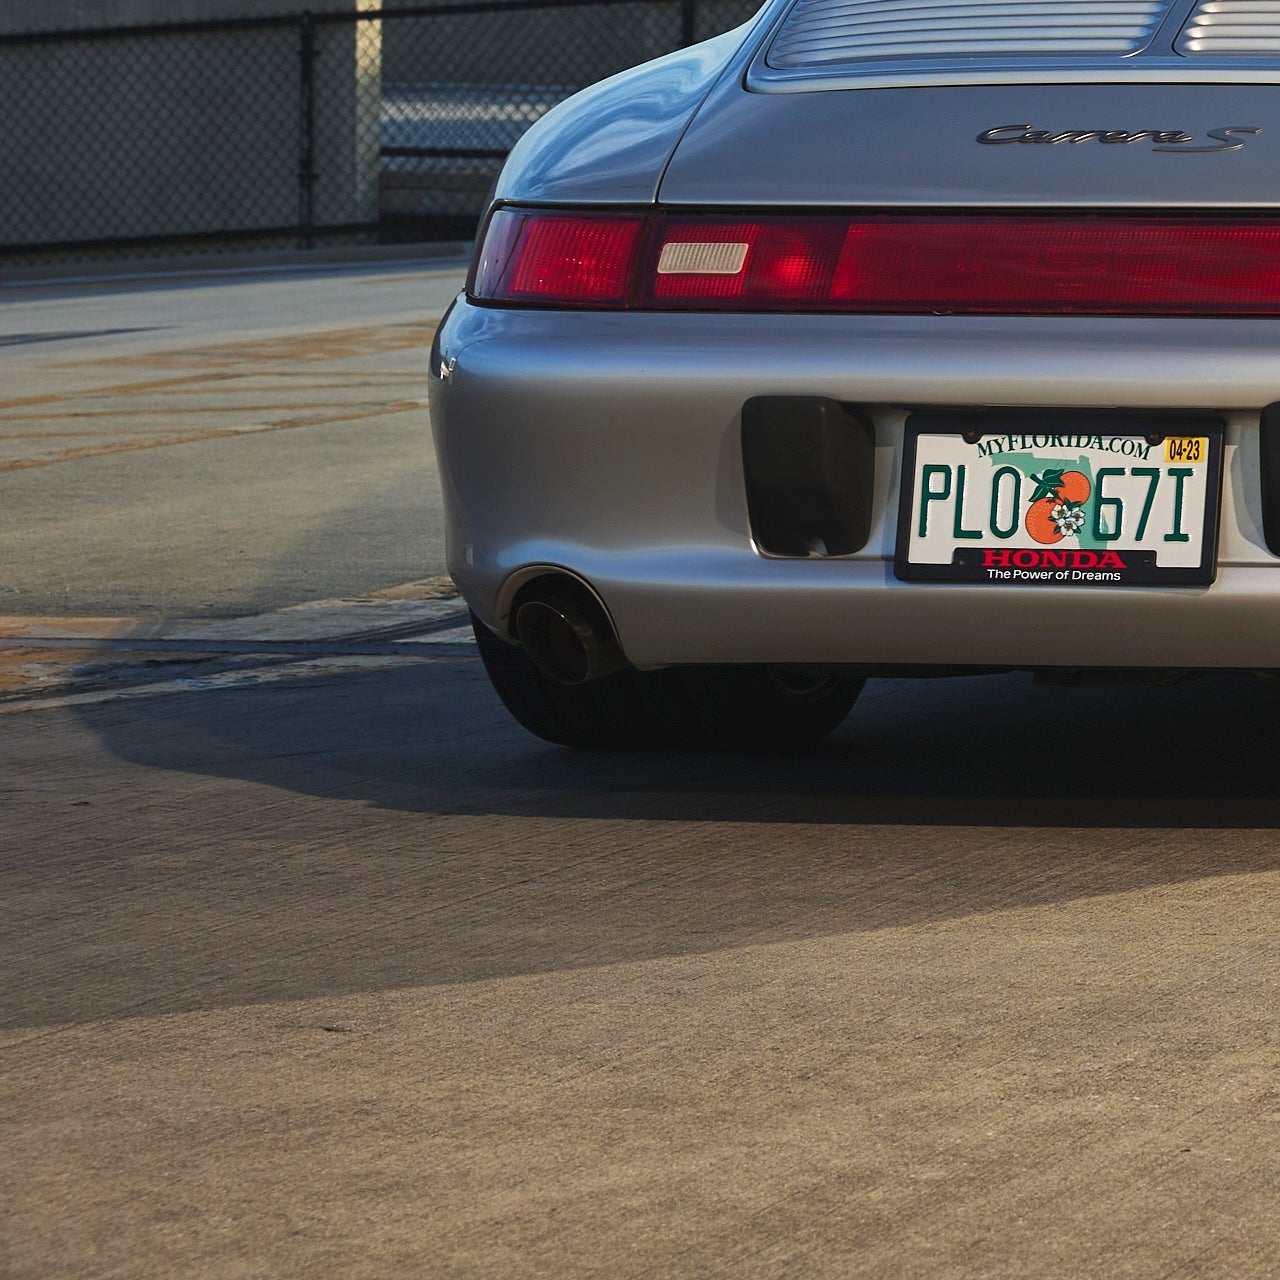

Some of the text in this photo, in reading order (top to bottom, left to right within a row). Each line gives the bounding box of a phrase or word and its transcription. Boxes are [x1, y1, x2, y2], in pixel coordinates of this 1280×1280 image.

[976, 123, 1263, 152] Carrera S
[977, 434, 1152, 460] MYFLORIDA.COM
[982, 549, 1127, 568] HONDA
[987, 568, 1121, 581] The Power of Dreams
